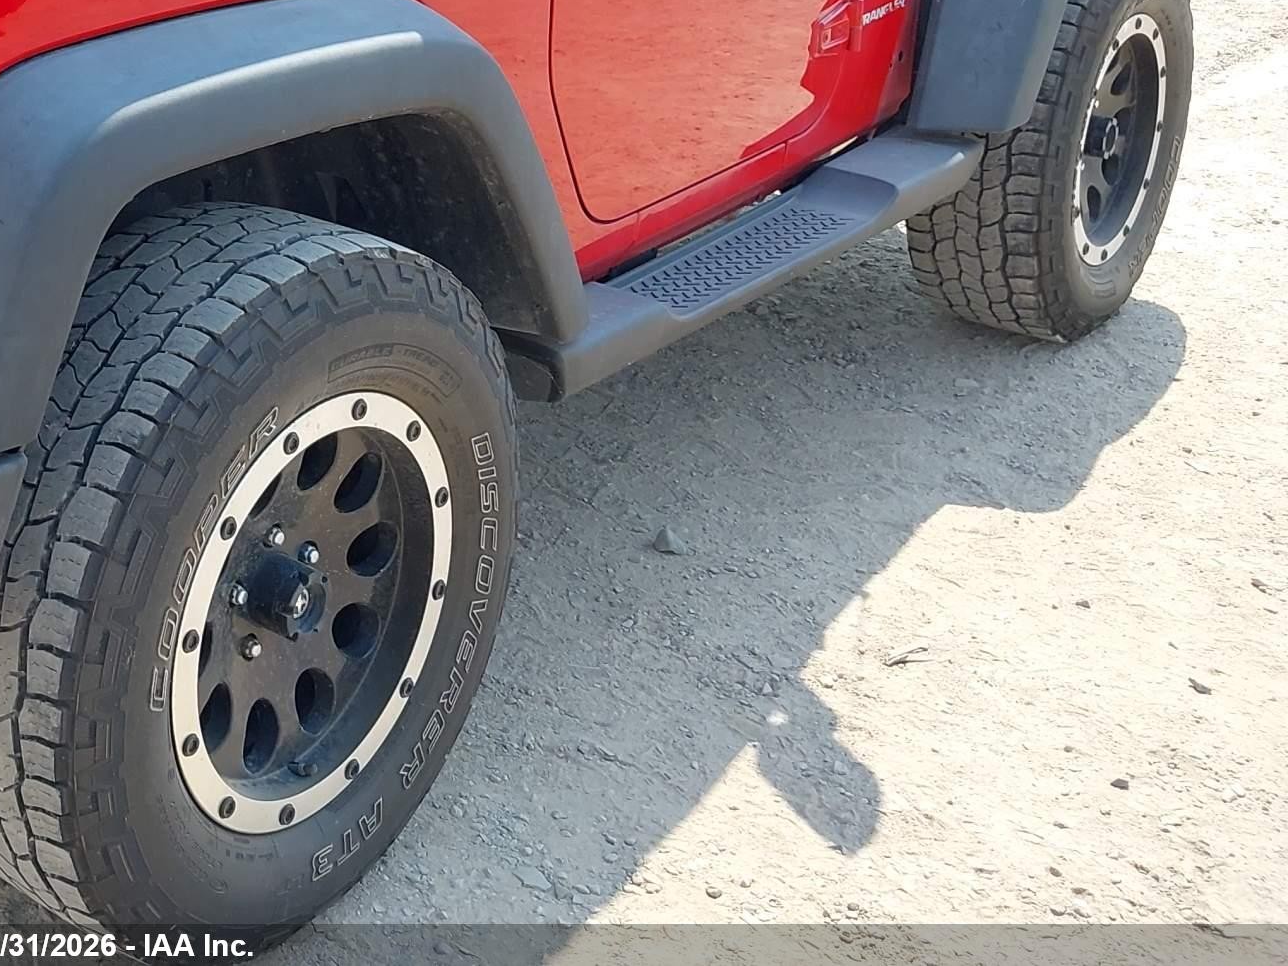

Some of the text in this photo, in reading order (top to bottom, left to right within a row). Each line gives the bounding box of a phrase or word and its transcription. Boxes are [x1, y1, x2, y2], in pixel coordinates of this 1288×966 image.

[149, 405, 281, 713] COOPER
[310, 431, 501, 882] DISCOVERER AT3
